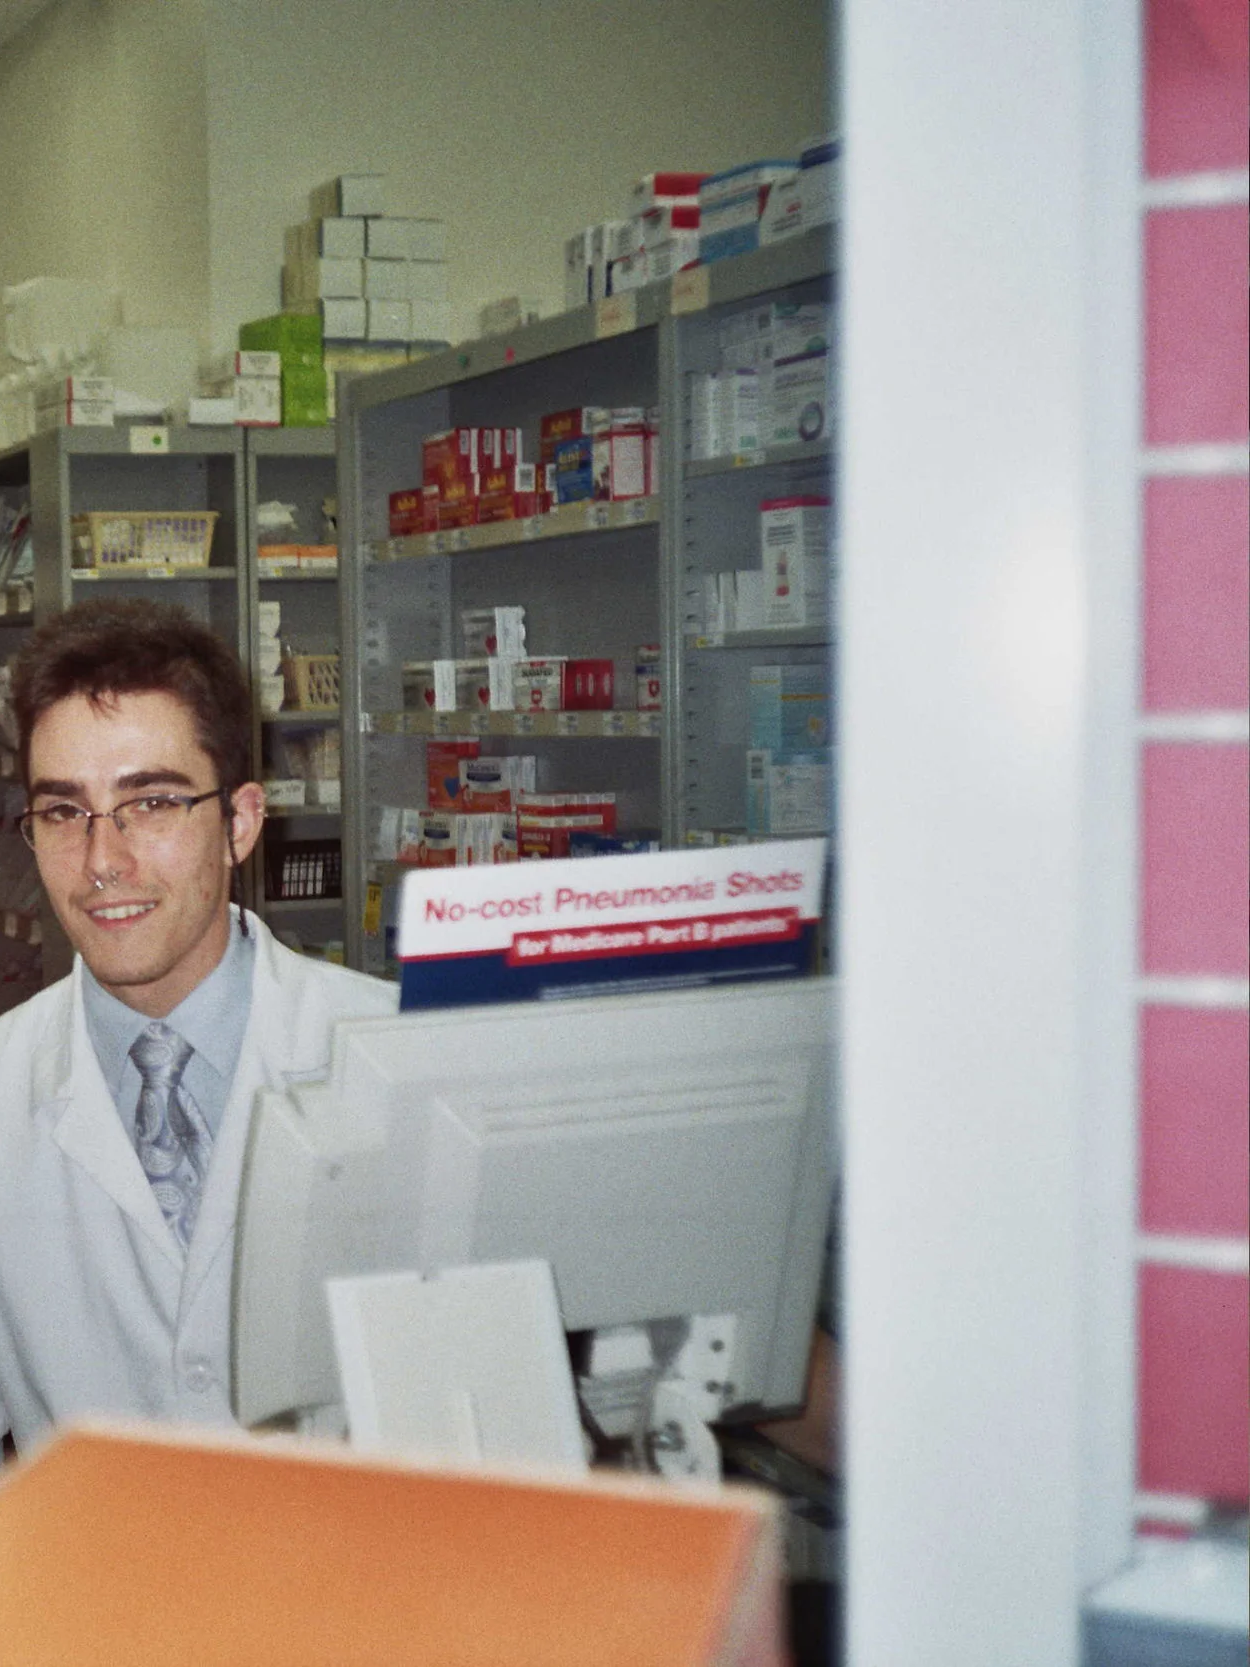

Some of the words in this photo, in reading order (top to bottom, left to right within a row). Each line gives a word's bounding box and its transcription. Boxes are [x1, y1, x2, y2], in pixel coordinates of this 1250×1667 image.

[425, 892, 542, 922] No-cost
[554, 877, 714, 912] Pneumonia
[726, 869, 803, 898] Shots
[551, 929, 644, 955] Medicare
[647, 924, 691, 945] Part
